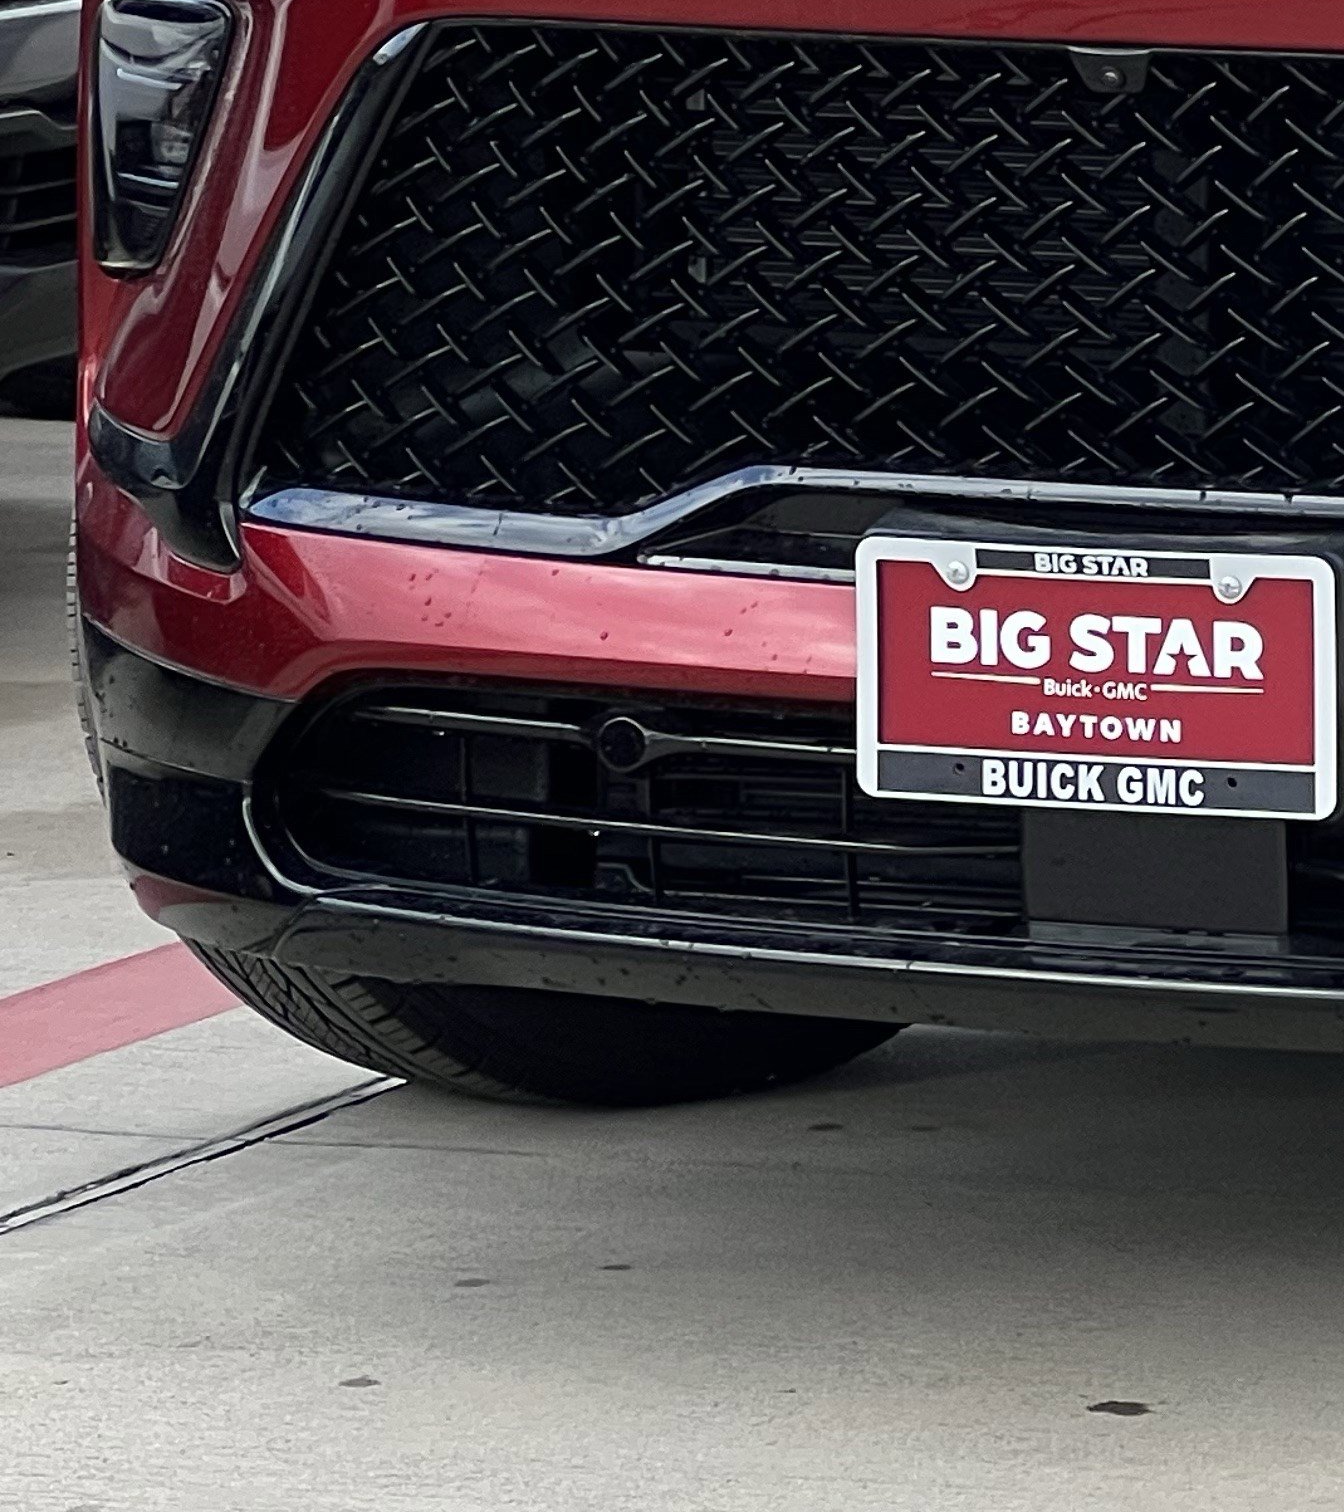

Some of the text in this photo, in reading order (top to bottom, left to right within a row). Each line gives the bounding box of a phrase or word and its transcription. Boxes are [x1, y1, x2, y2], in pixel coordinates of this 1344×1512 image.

[1033, 553, 1149, 578] BIG STAR
[929, 605, 1265, 681] BIG STAR
[1043, 677, 1149, 701] Buick GMC
[1010, 710, 1183, 744] BAYTOWN
[981, 759, 1206, 807] BUICK GMC
